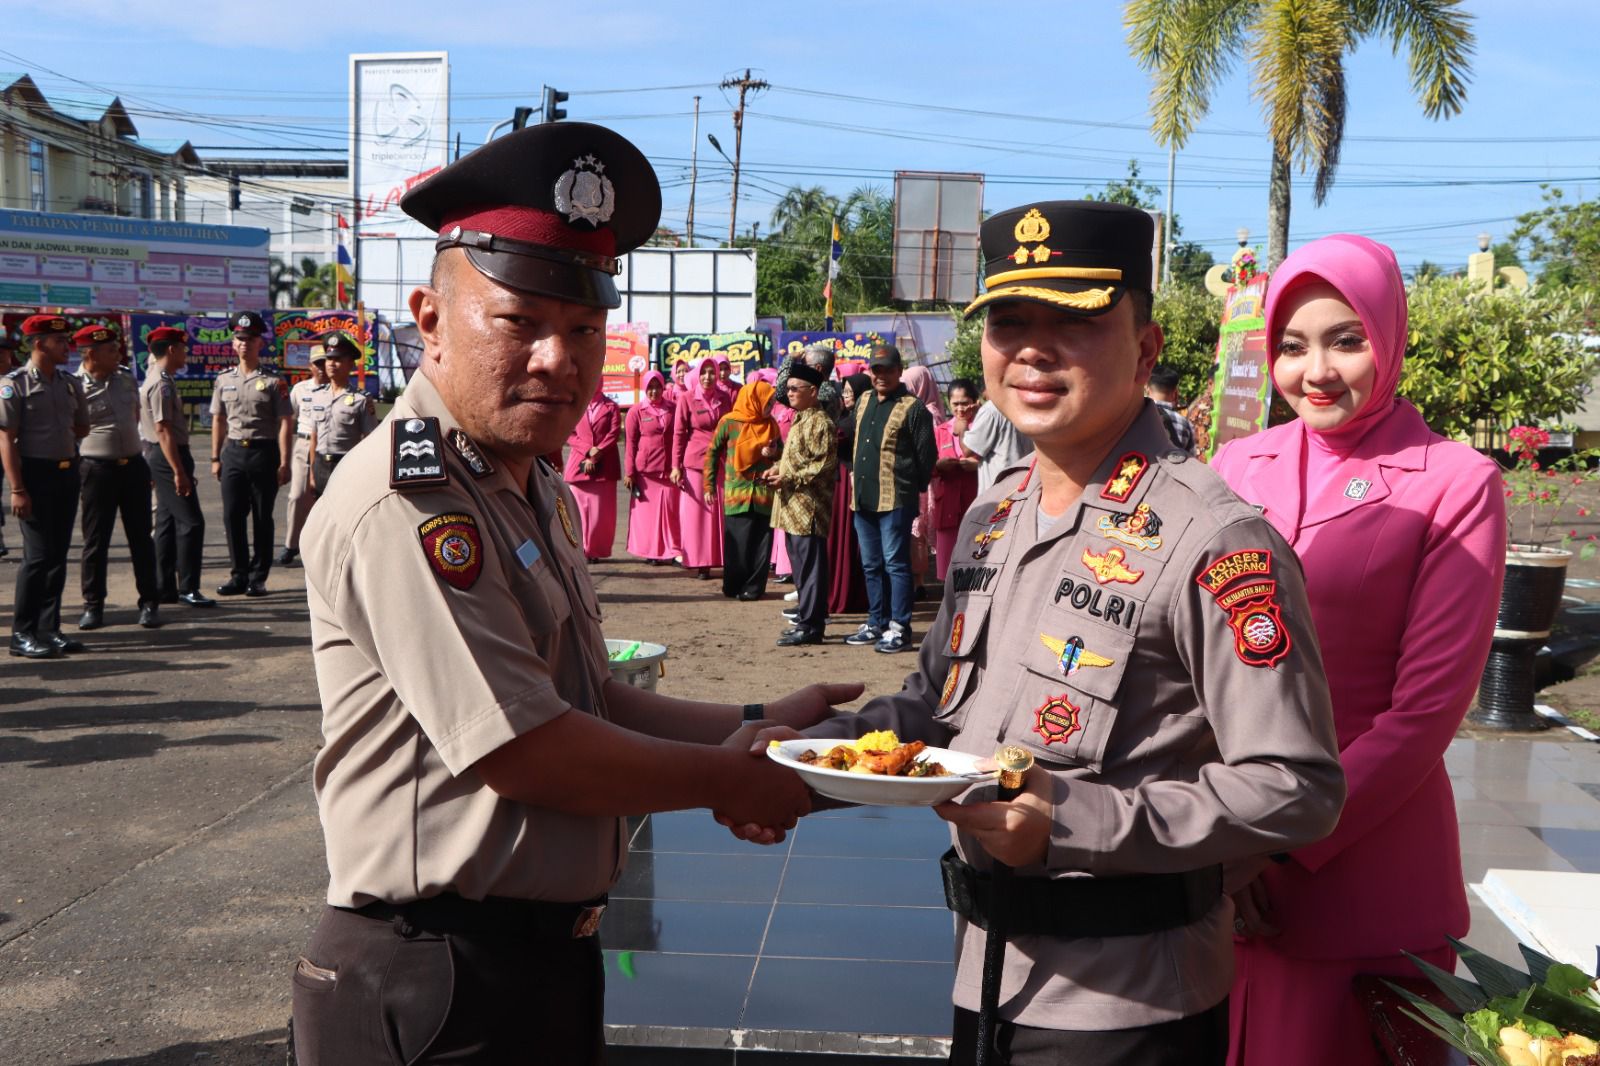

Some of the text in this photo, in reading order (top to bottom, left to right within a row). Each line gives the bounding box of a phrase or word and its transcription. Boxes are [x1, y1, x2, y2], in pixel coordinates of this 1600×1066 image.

[11, 215, 79, 230] TAHAPAN
[83, 220, 139, 234] PEMILU
[153, 225, 229, 241] PEMILIHAN
[0, 240, 129, 256] AN DAN JADWAL PEMILU 2024
[602, 364, 626, 373] APANG
[398, 466, 440, 477] POLISI
[420, 517, 443, 535] KORPS
[1208, 553, 1259, 579] POLRES
[1210, 562, 1267, 589] KETAPANG
[1055, 577, 1137, 629] POLRI
